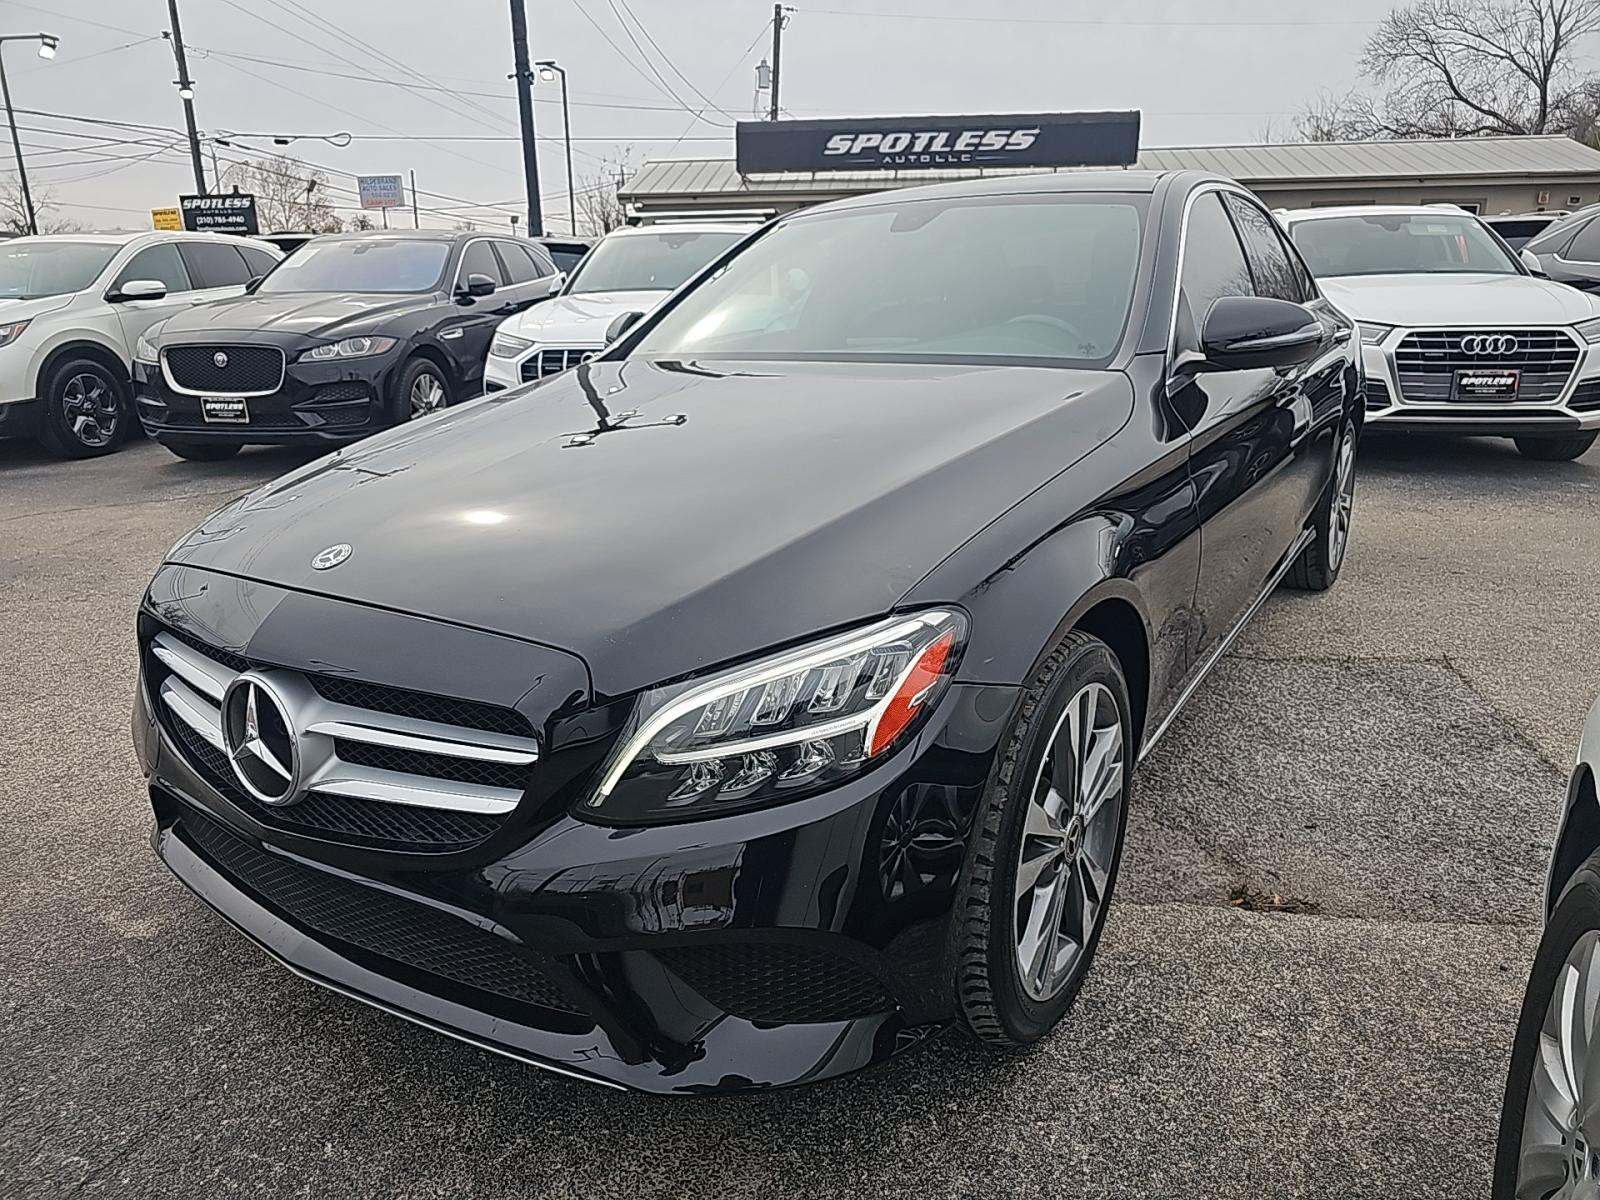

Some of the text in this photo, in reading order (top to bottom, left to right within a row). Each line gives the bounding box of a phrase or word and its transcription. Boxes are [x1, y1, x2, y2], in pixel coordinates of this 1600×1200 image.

[824, 126, 1041, 155] SPOTLESS
[183, 198, 251, 209] SPOTLESS
[1460, 377, 1515, 385] SPOTLESS
